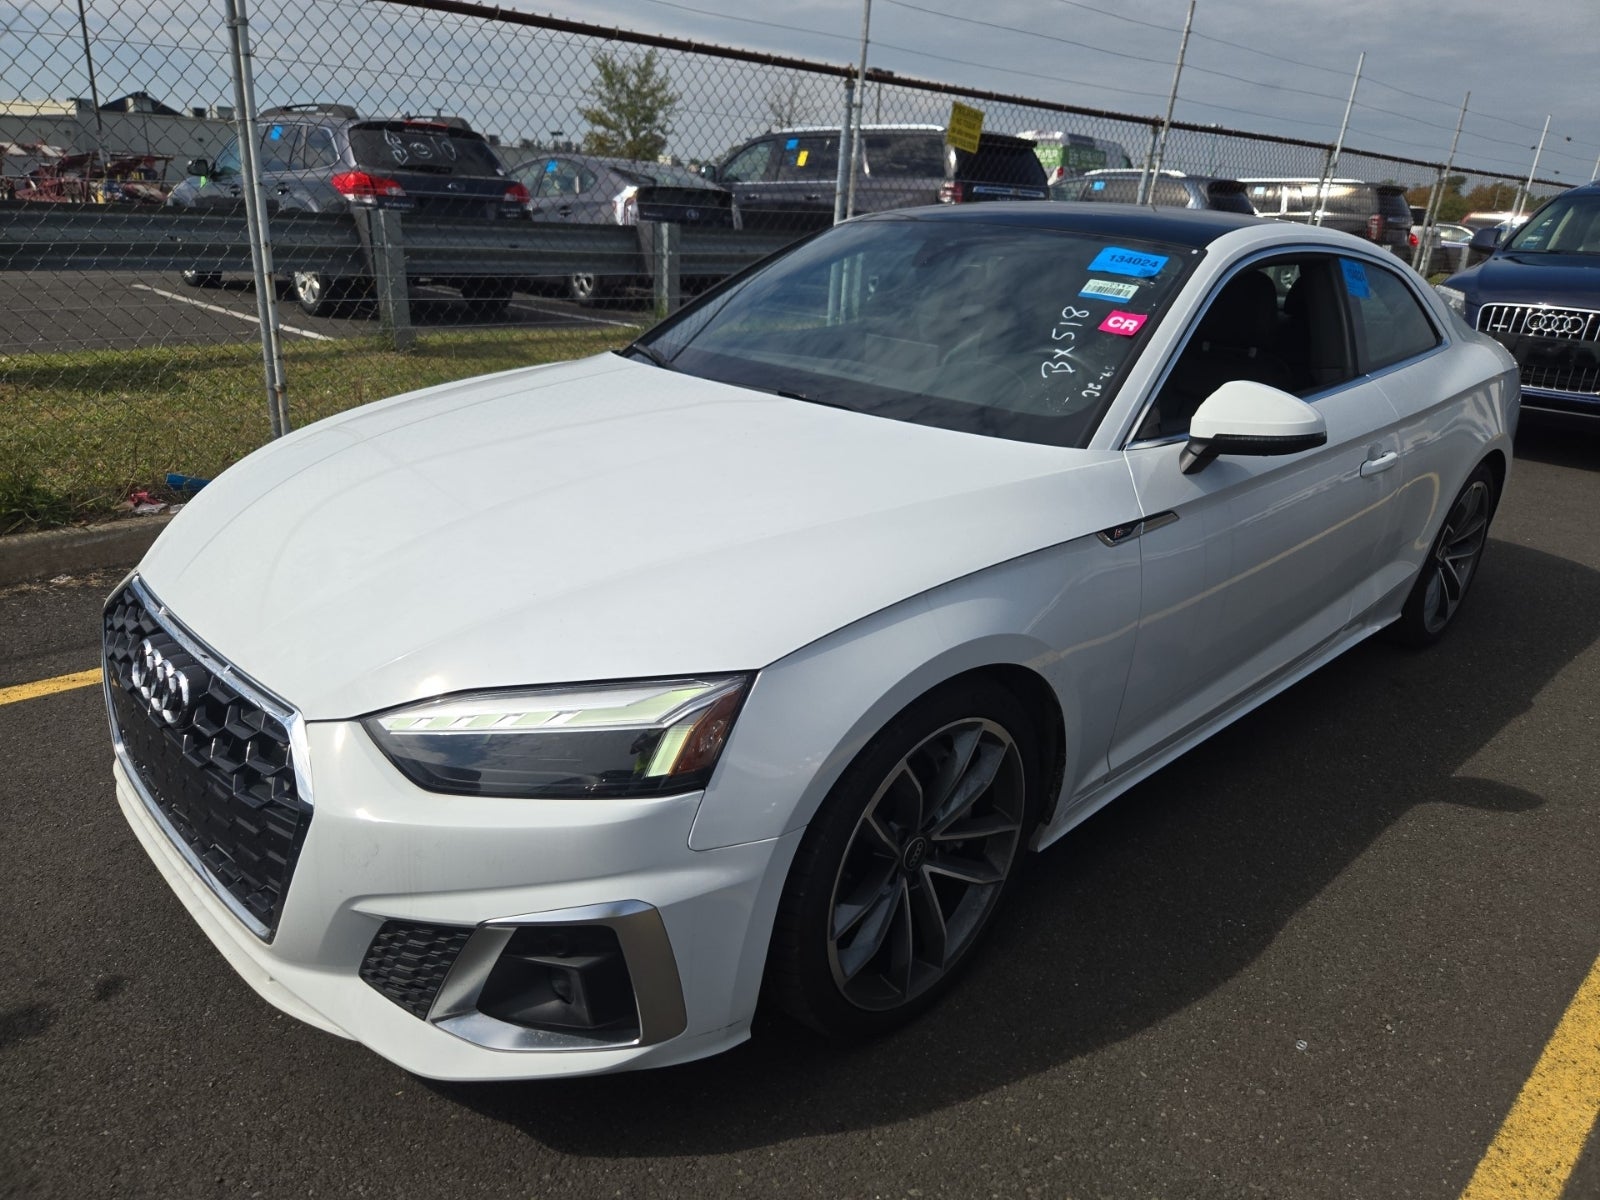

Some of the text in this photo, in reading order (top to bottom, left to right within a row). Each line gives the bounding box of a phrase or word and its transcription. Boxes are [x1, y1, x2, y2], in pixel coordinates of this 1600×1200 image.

[1109, 254, 1159, 268] 134024
[1107, 316, 1139, 332] CR
[1041, 306, 1090, 378] BX518
